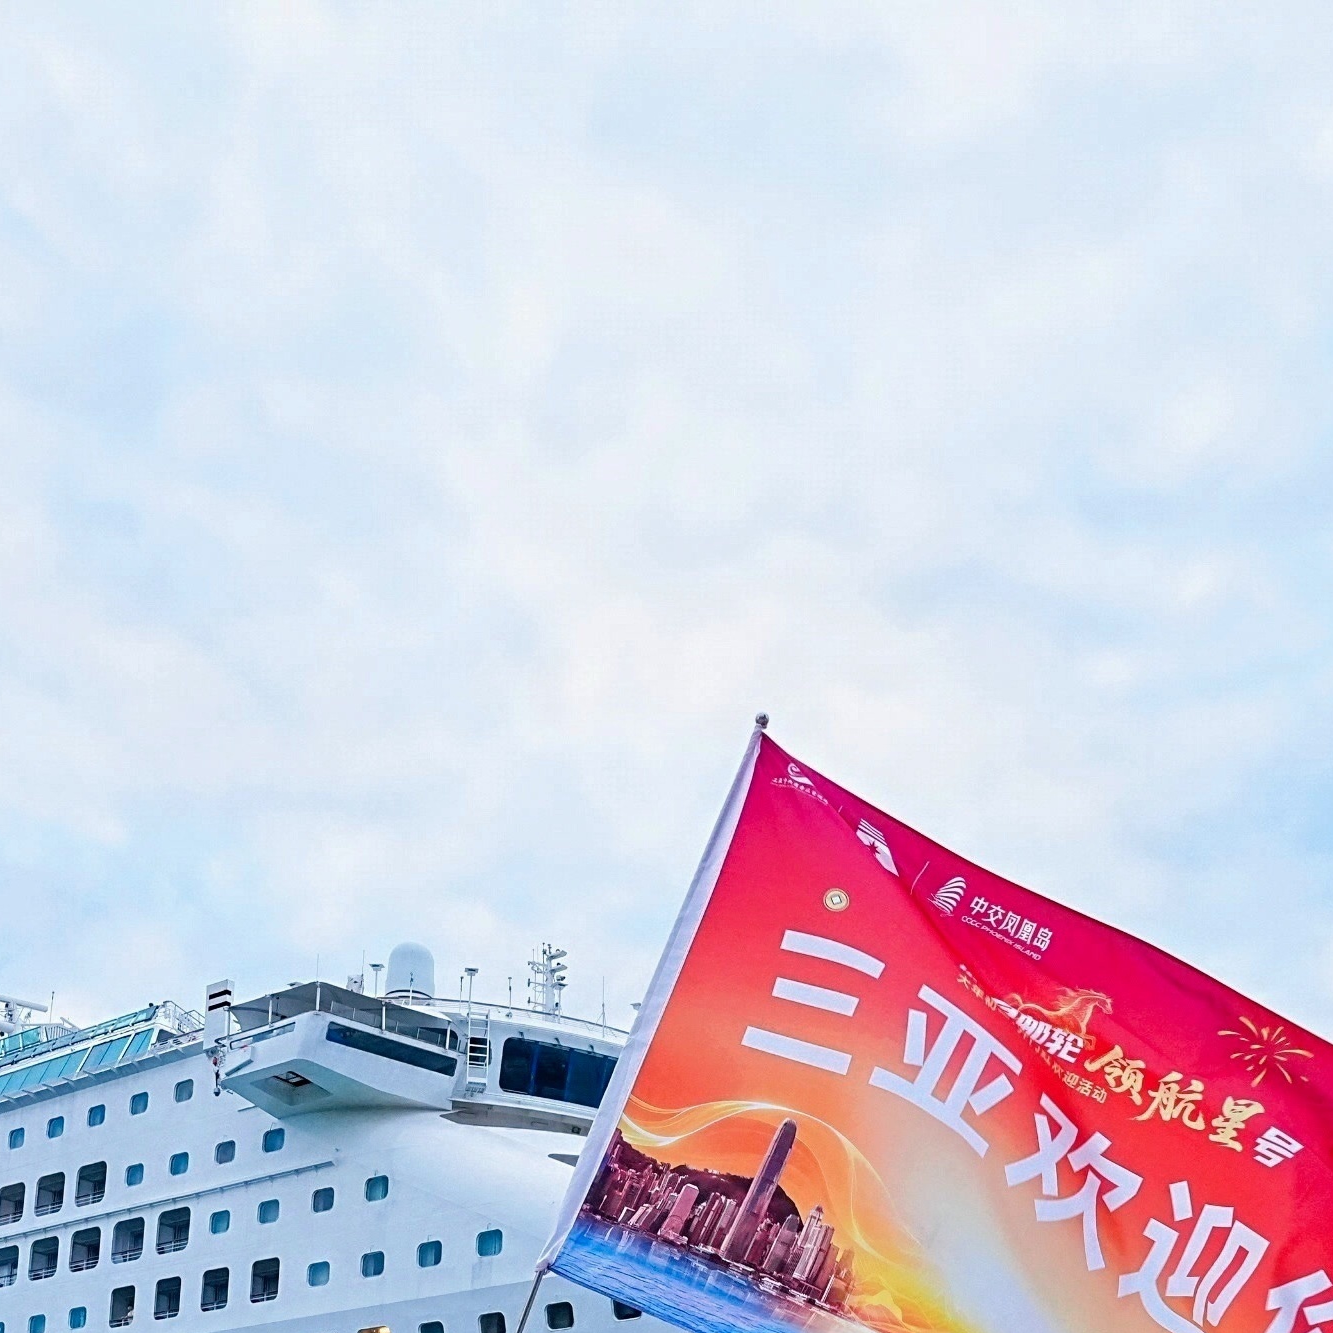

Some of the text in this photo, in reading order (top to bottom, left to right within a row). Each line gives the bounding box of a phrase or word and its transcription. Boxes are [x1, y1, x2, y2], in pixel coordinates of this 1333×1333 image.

[961, 915, 1042, 961] CCCC PHOENIX ISLAND
[969, 896, 1053, 952] 中交凤凰岛
